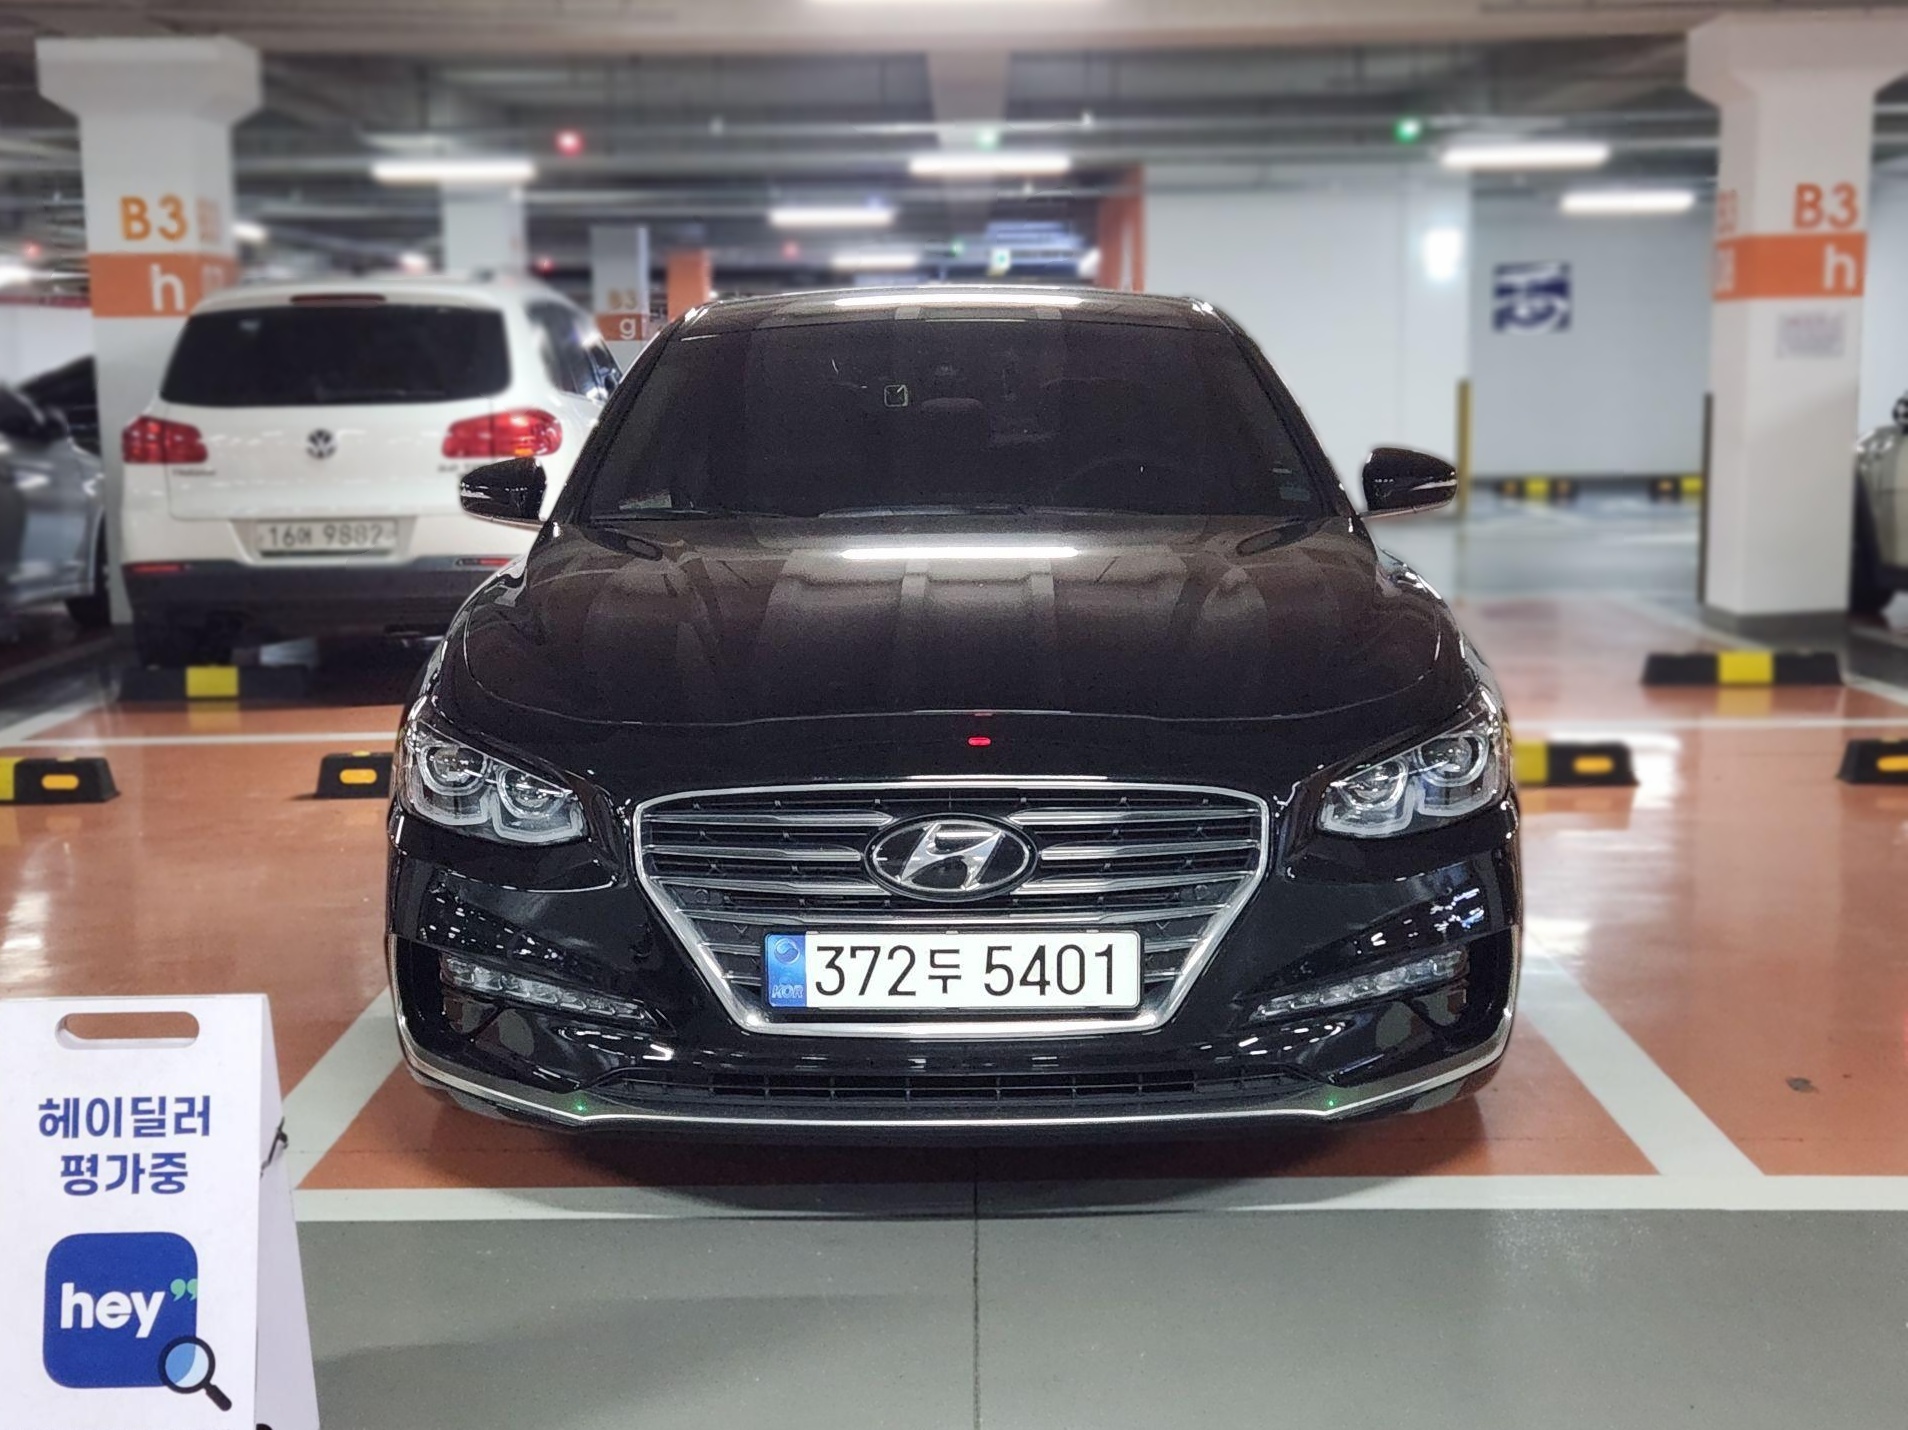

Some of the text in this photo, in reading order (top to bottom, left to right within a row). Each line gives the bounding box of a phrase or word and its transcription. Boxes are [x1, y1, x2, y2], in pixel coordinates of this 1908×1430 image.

[119, 194, 189, 242] B3
[1793, 181, 1859, 230] B3
[150, 262, 186, 312] h
[1821, 244, 1857, 291] h
[618, 317, 637, 340] g
[771, 984, 804, 999] KOR
[814, 943, 1115, 997] 372두 5401
[38, 1095, 212, 1139] 헤이딜러
[60, 1151, 189, 1197] 평가중
